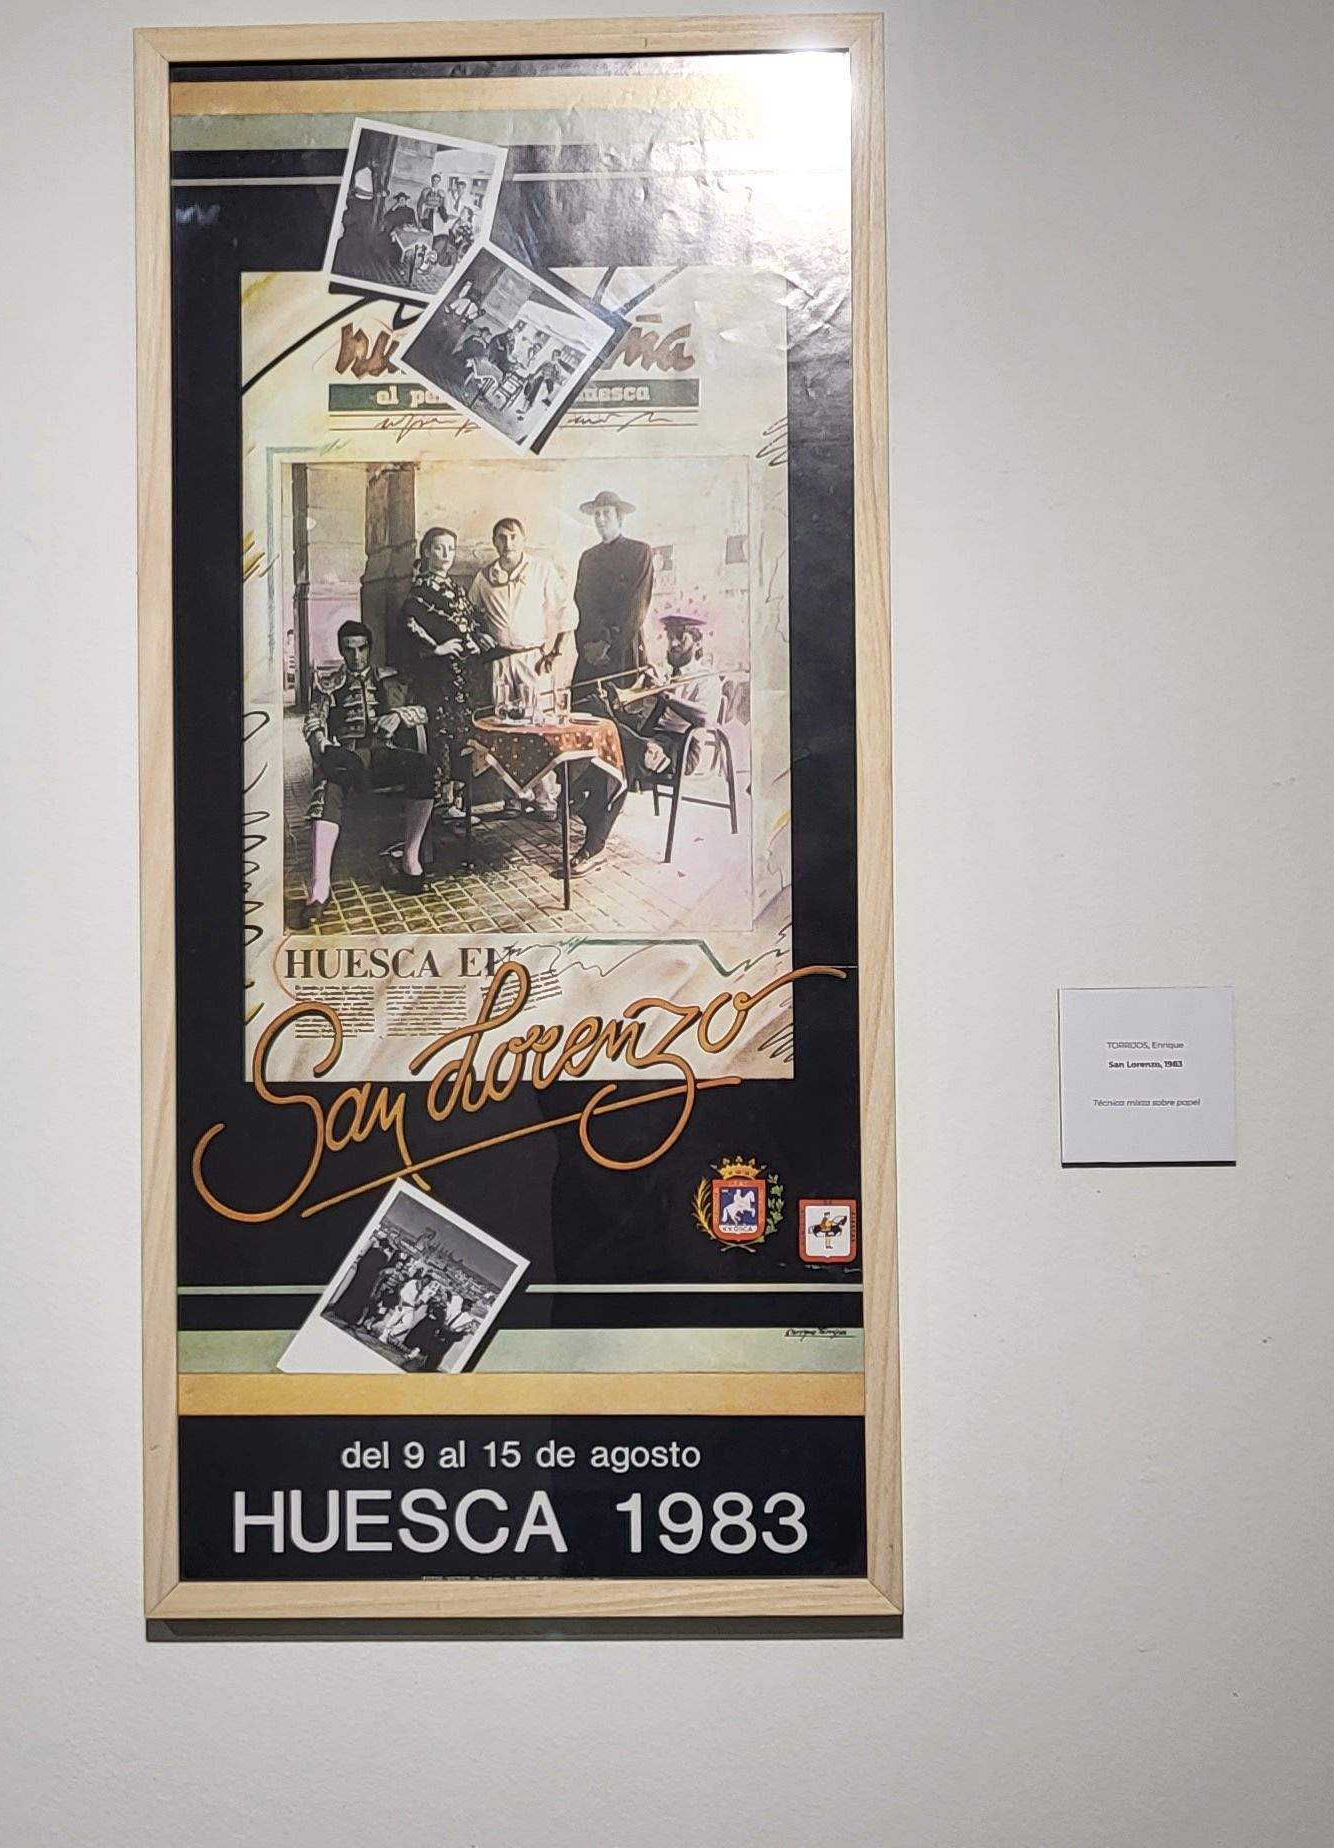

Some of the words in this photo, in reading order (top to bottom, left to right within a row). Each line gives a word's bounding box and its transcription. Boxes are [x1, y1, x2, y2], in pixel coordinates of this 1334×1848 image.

[285, 947, 442, 979] HUESCA
[1152, 1041, 1185, 1050] Enrique
[1108, 1060, 1125, 1068] San
[1127, 1060, 1163, 1069] Lorenzo,
[193, 1001, 431, 1223] San
[409, 961, 848, 1171] Lorenzo
[341, 1440, 390, 1469] del
[403, 1441, 425, 1469] 9
[439, 1440, 466, 1469] al
[483, 1440, 522, 1468] 15
[535, 1439, 576, 1468] de
[590, 1441, 701, 1474] agosto
[234, 1488, 568, 1554] HUESCA
[616, 1491, 808, 1554] 1983
